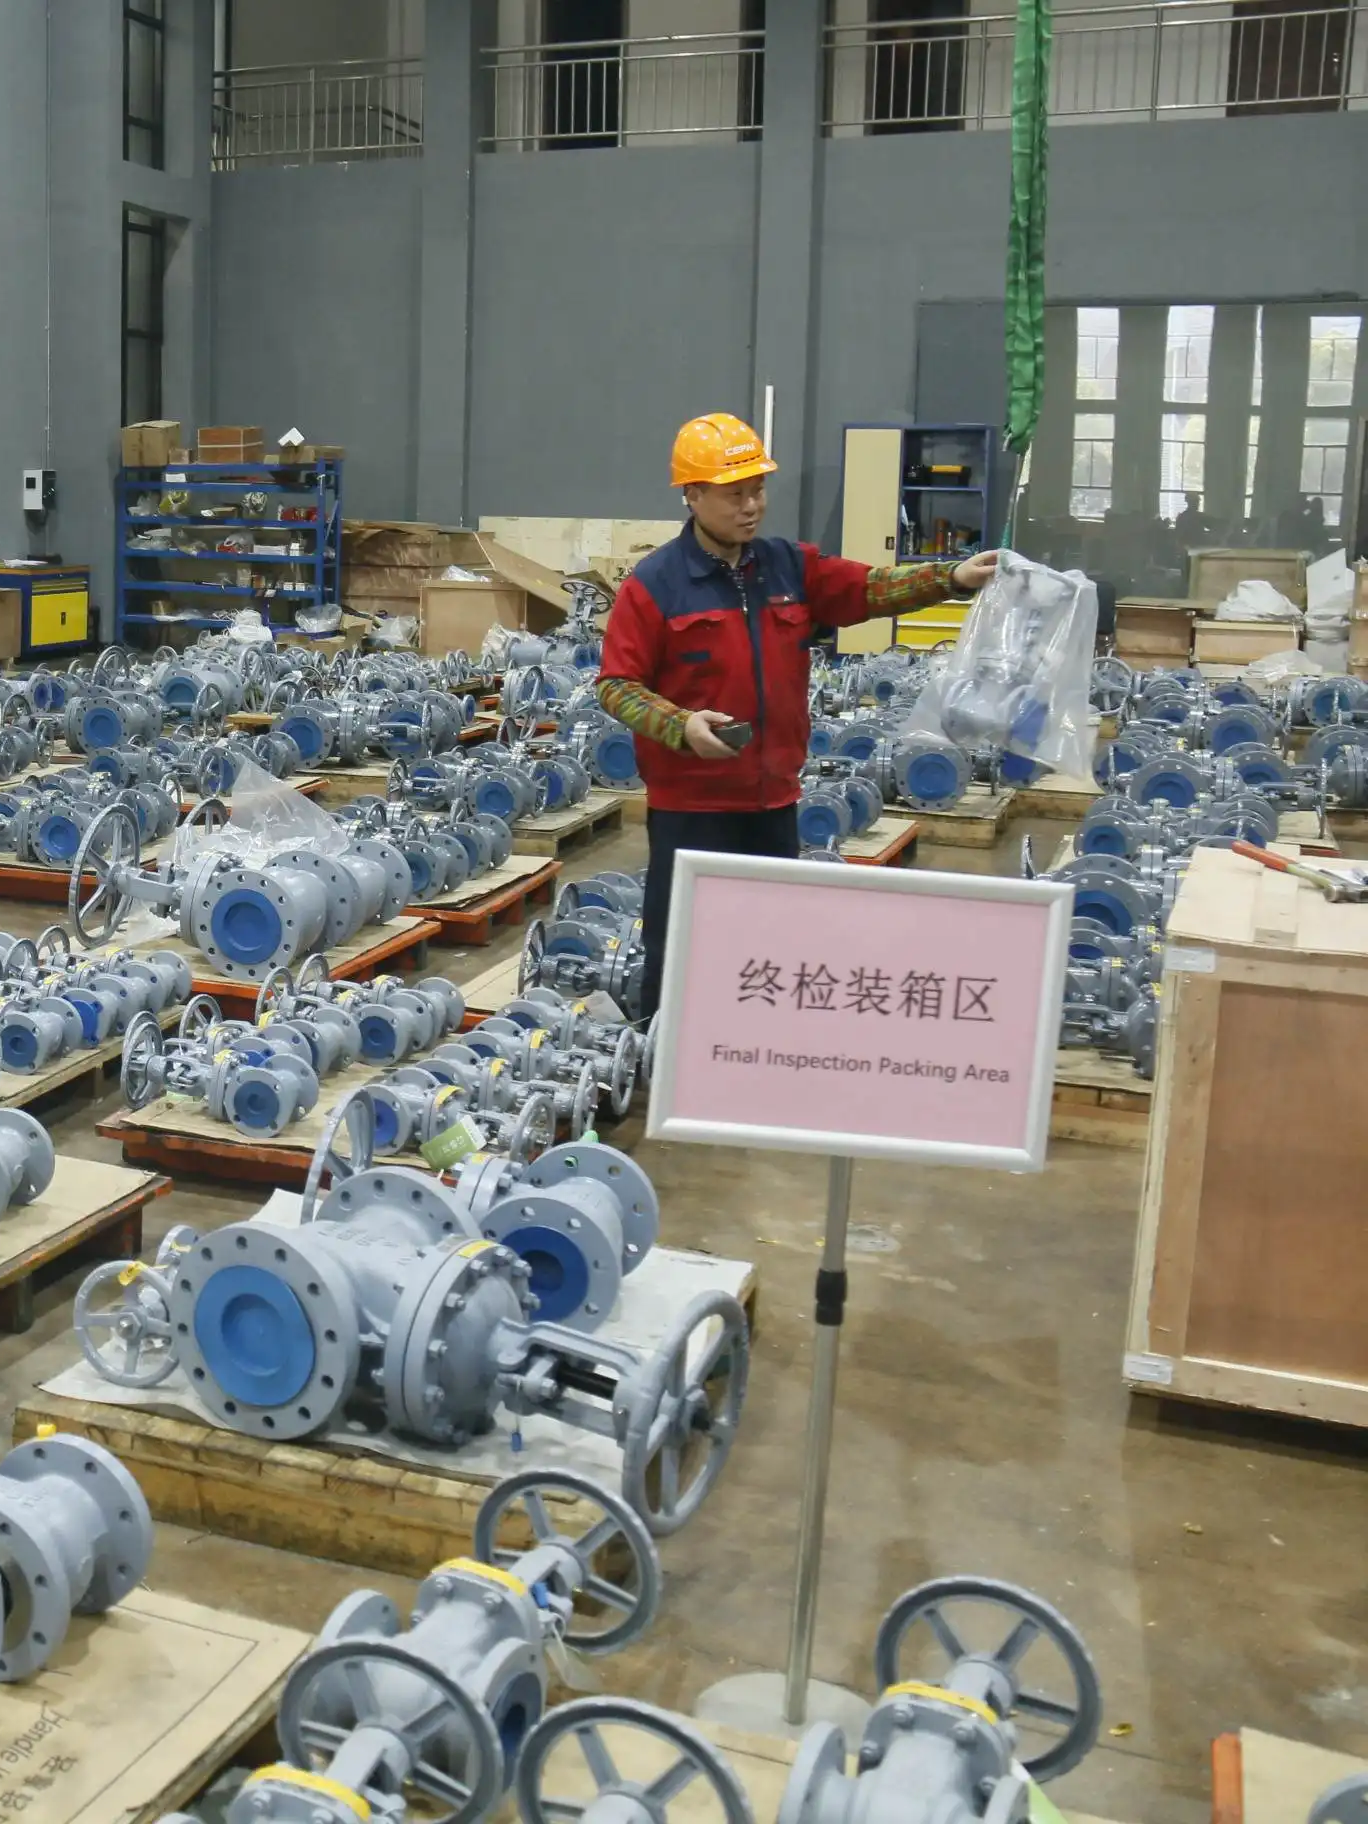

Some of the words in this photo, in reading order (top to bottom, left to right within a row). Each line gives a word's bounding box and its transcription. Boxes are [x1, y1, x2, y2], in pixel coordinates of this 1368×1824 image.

[736, 957, 999, 1024] 终检装箱区
[711, 1044, 760, 1065] Final
[766, 1048, 871, 1074] Inspection
[878, 1056, 957, 1082] Packing
[963, 1063, 1010, 1084] Area
[0, 1707, 70, 1763] Handle
